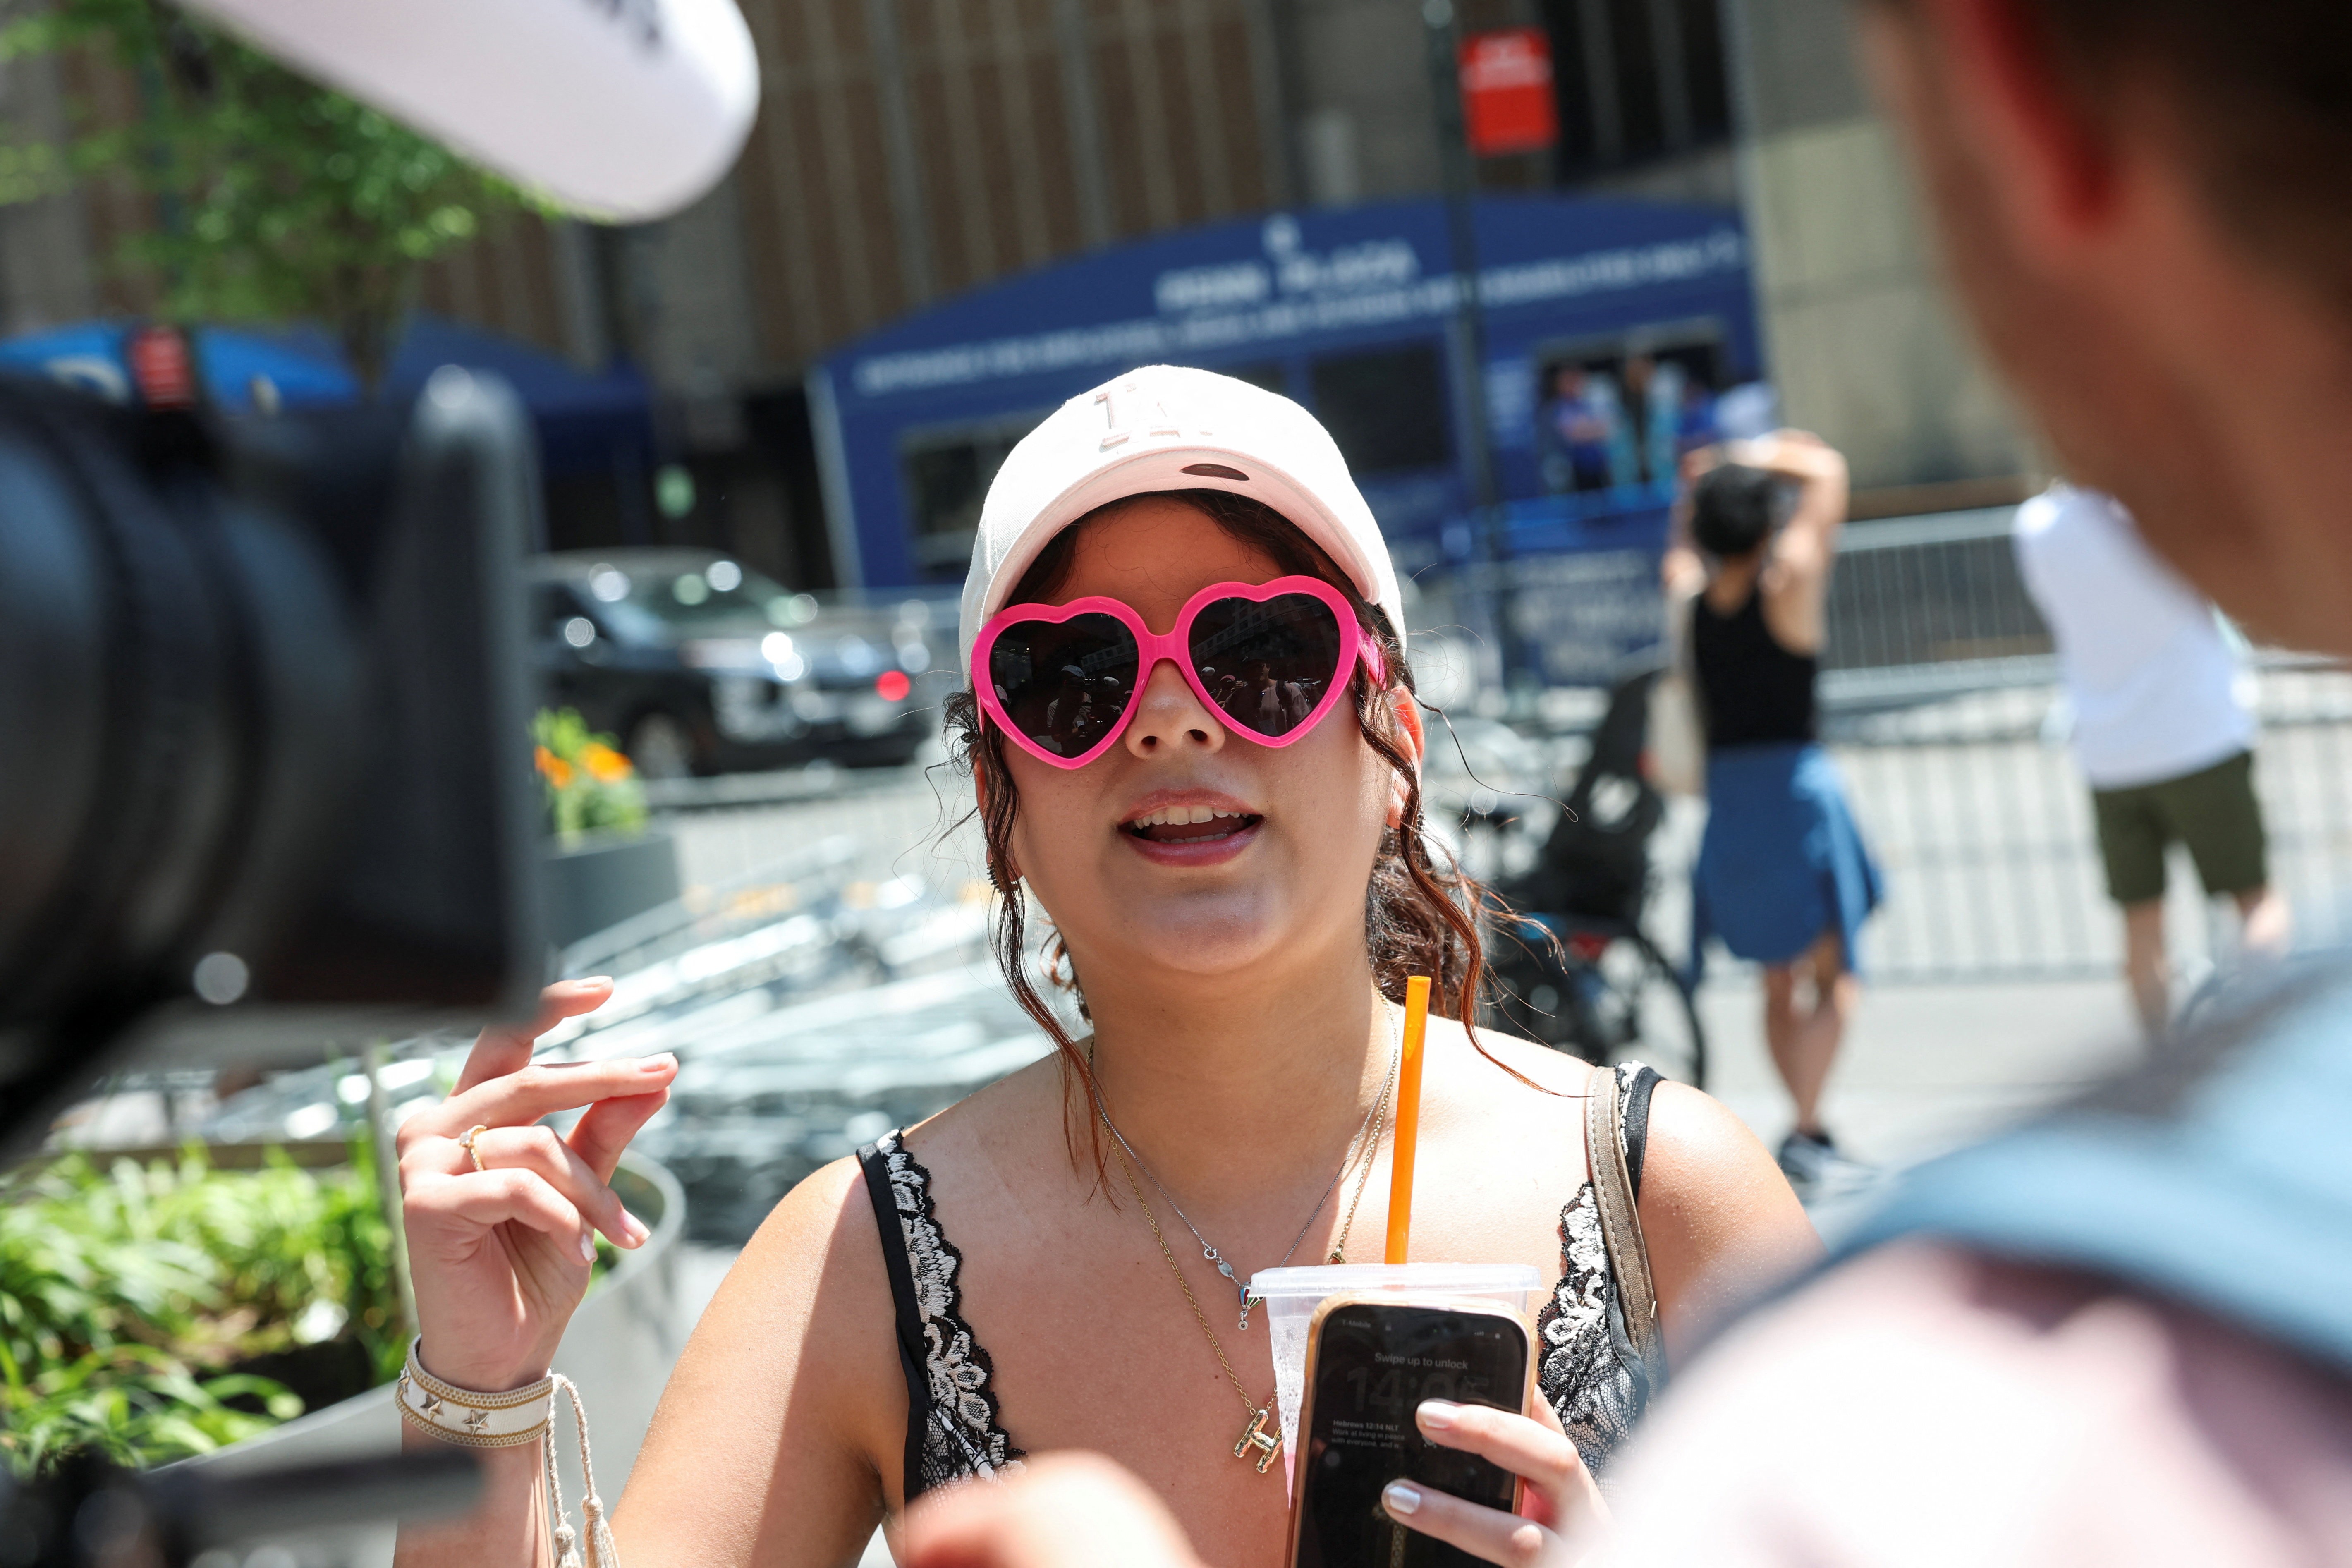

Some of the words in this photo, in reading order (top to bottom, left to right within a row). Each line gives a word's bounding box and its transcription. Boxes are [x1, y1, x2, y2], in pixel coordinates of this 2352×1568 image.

[1342, 1319, 1371, 1329] T-Mobile
[1374, 1352, 1405, 1365] Swipe
[1407, 1357, 1420, 1367] up
[1422, 1357, 1433, 1367] to
[1435, 1358, 1469, 1369] unlock
[1333, 1419, 1364, 1429] Hebrews
[1366, 1422, 1383, 1430] 12:14
